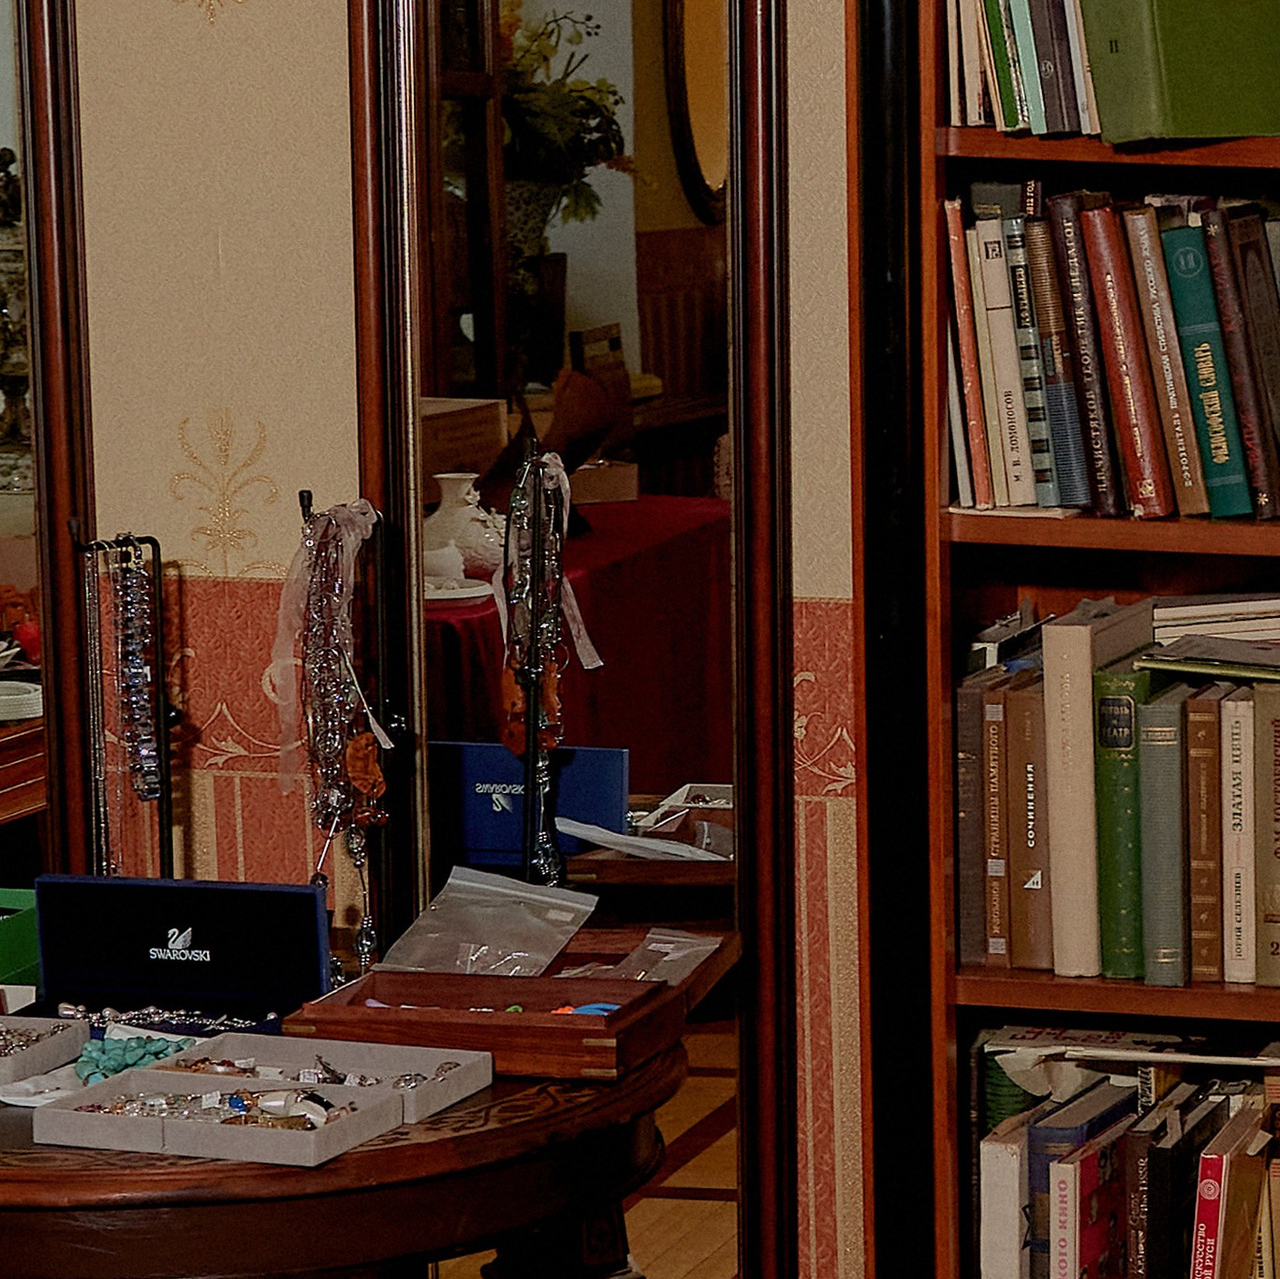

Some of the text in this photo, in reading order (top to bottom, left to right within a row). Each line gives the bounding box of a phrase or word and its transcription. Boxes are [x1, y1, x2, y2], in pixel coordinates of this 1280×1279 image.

[1026, 763, 1035, 848] СОЧИНЕНИЯ
[149, 948, 211, 962] SWAROVSKI
[1057, 1179, 1069, 1230] КИНО
